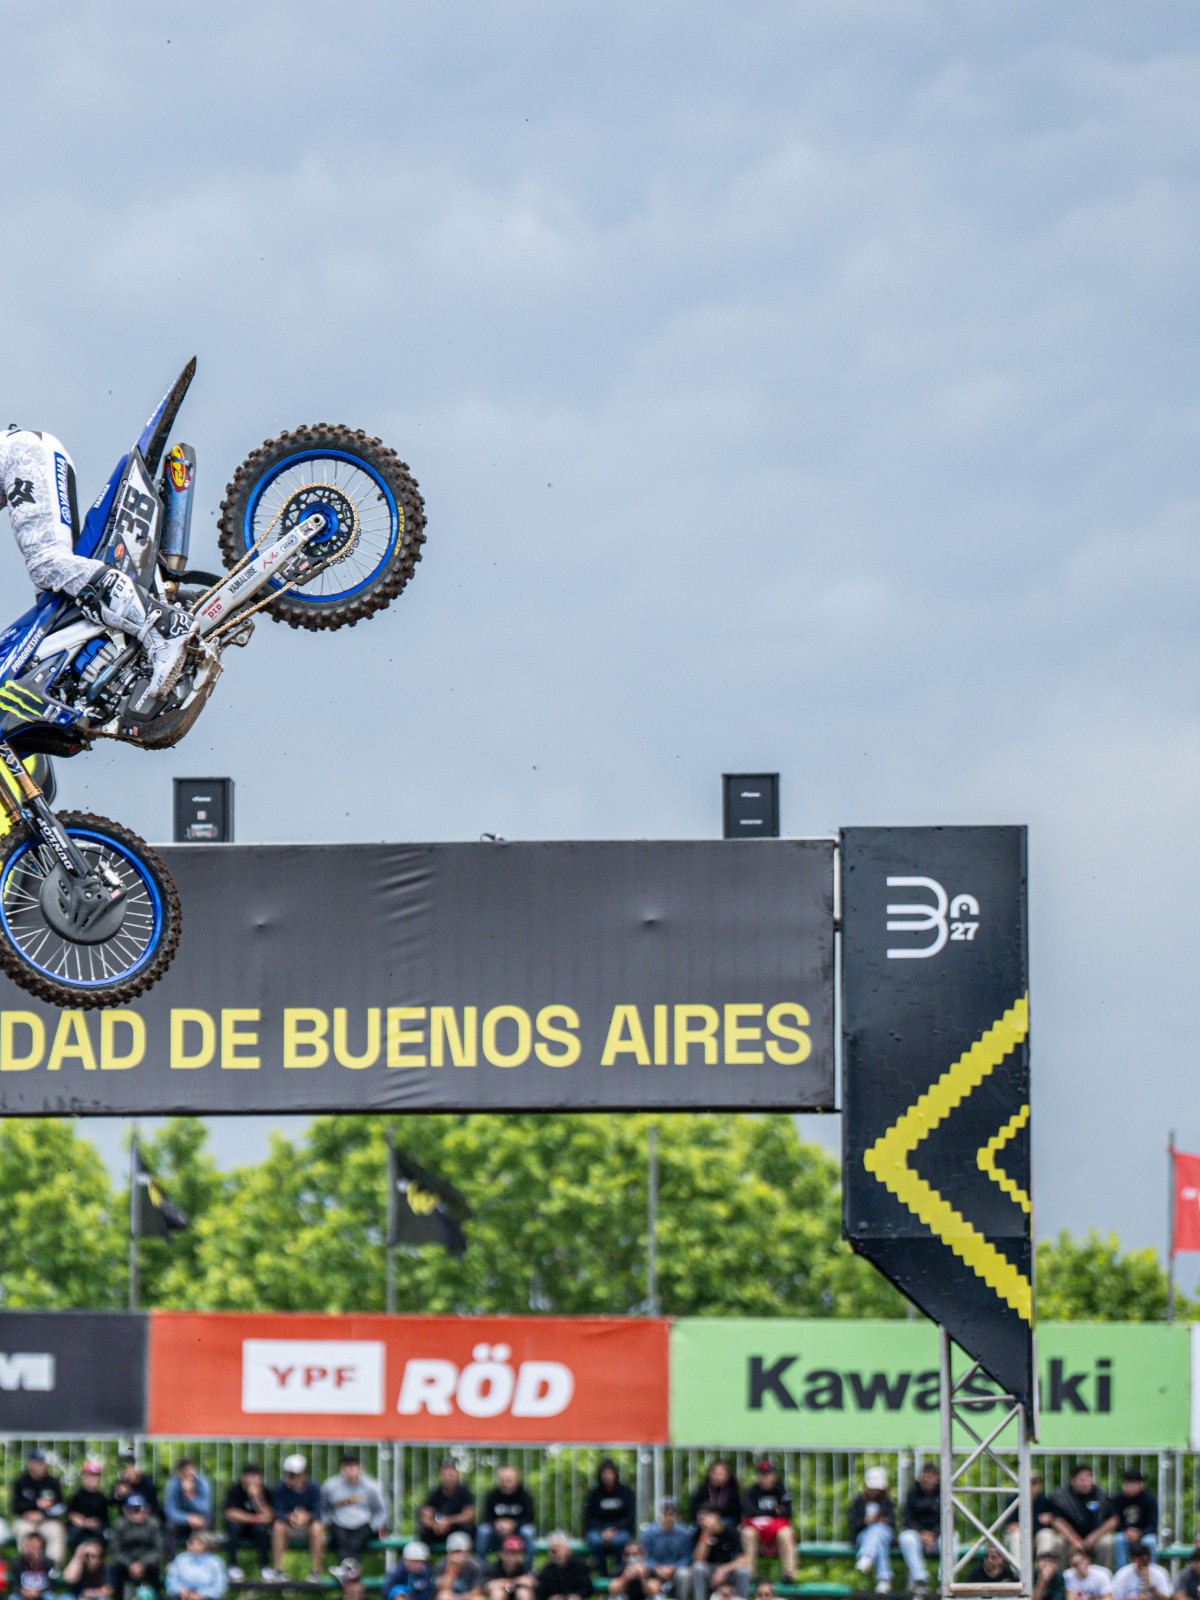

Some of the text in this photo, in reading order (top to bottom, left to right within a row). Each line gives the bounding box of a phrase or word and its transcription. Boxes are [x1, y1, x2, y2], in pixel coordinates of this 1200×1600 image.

[56, 456, 70, 506] YAMAHA
[92, 484, 111, 509] YAMAHA
[115, 484, 157, 548] 38
[394, 506, 405, 556] DUNLOP
[113, 578, 127, 599] FOX
[227, 565, 258, 594] YAMALUBE
[11, 627, 45, 673] PROGRESSIVE
[36, 817, 75, 872] DUNLOP
[950, 921, 980, 941] 27
[170, 1008, 261, 1069] DE
[283, 1004, 581, 1070] BUENOS
[600, 1002, 813, 1066] AIRES
[270, 1342, 575, 1418] YPF RÖD
[747, 1356, 1113, 1413] Kawaski
